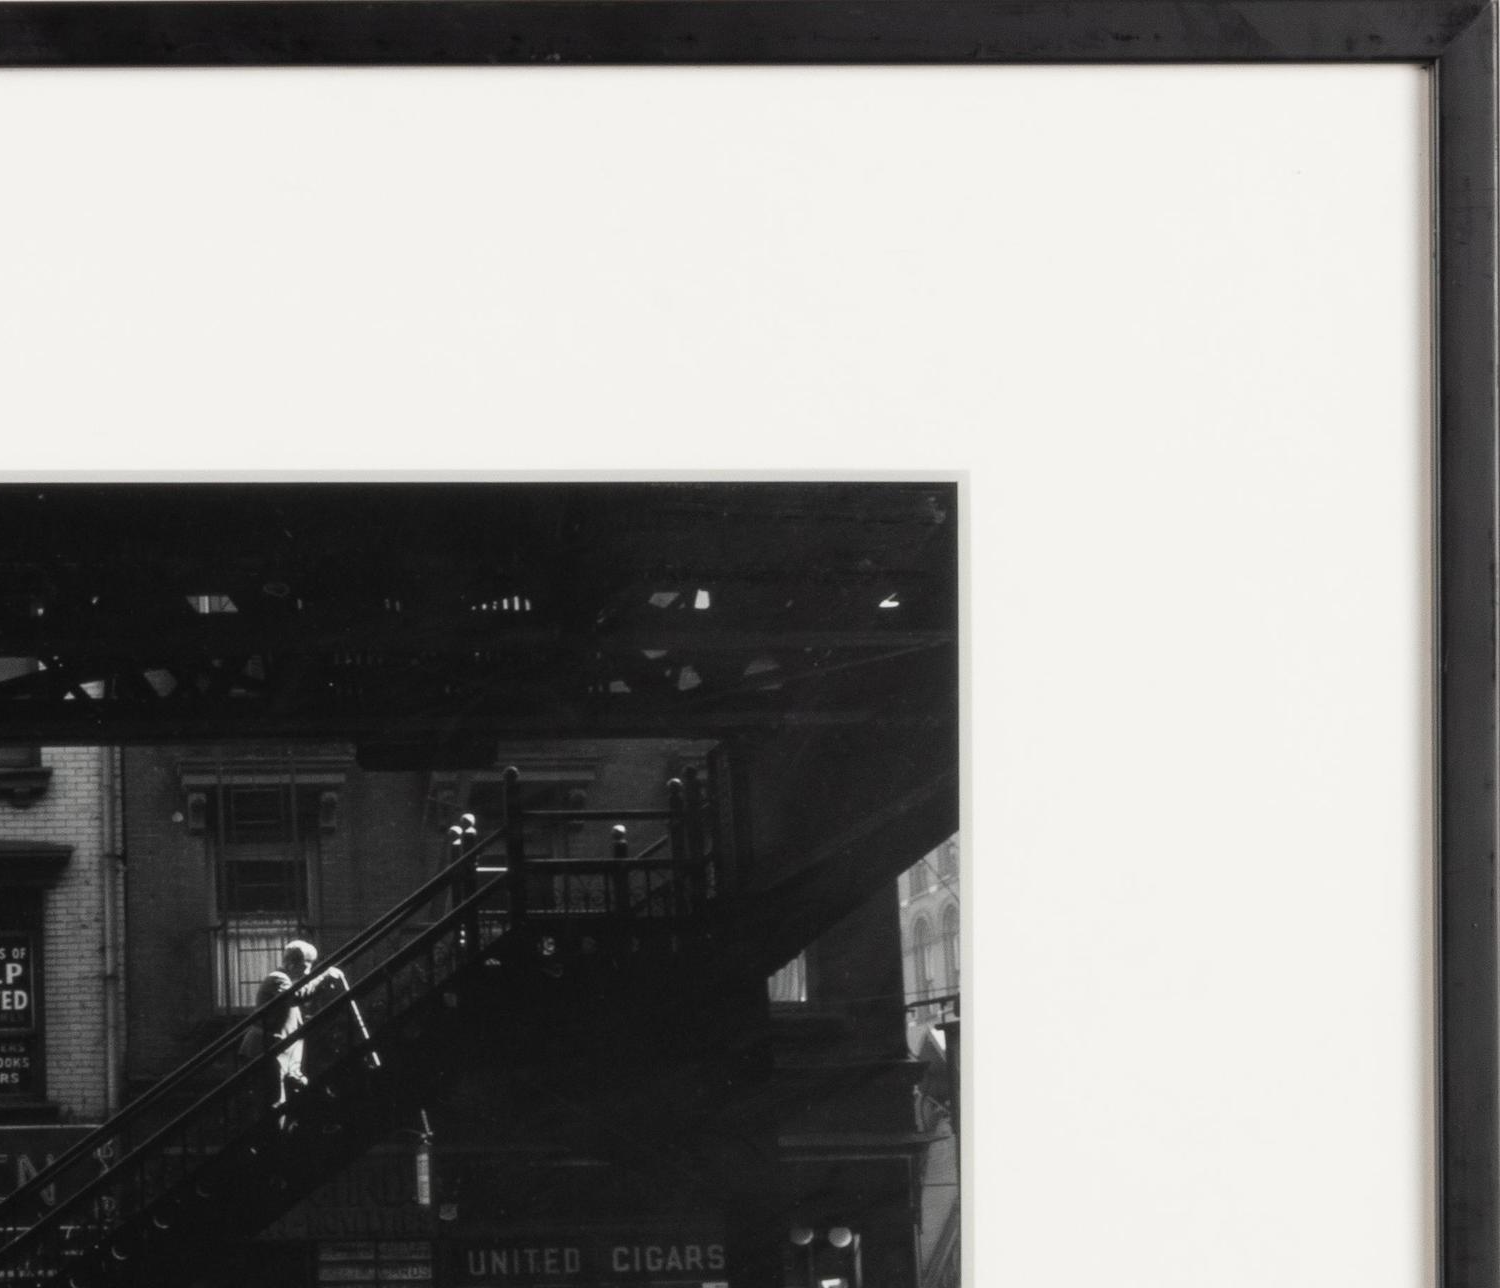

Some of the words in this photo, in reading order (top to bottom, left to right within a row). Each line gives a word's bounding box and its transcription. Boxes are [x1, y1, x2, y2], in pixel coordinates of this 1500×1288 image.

[12, 947, 27, 960] OF
[468, 1247, 581, 1276] UNITED
[612, 1244, 726, 1272] CIGARS
